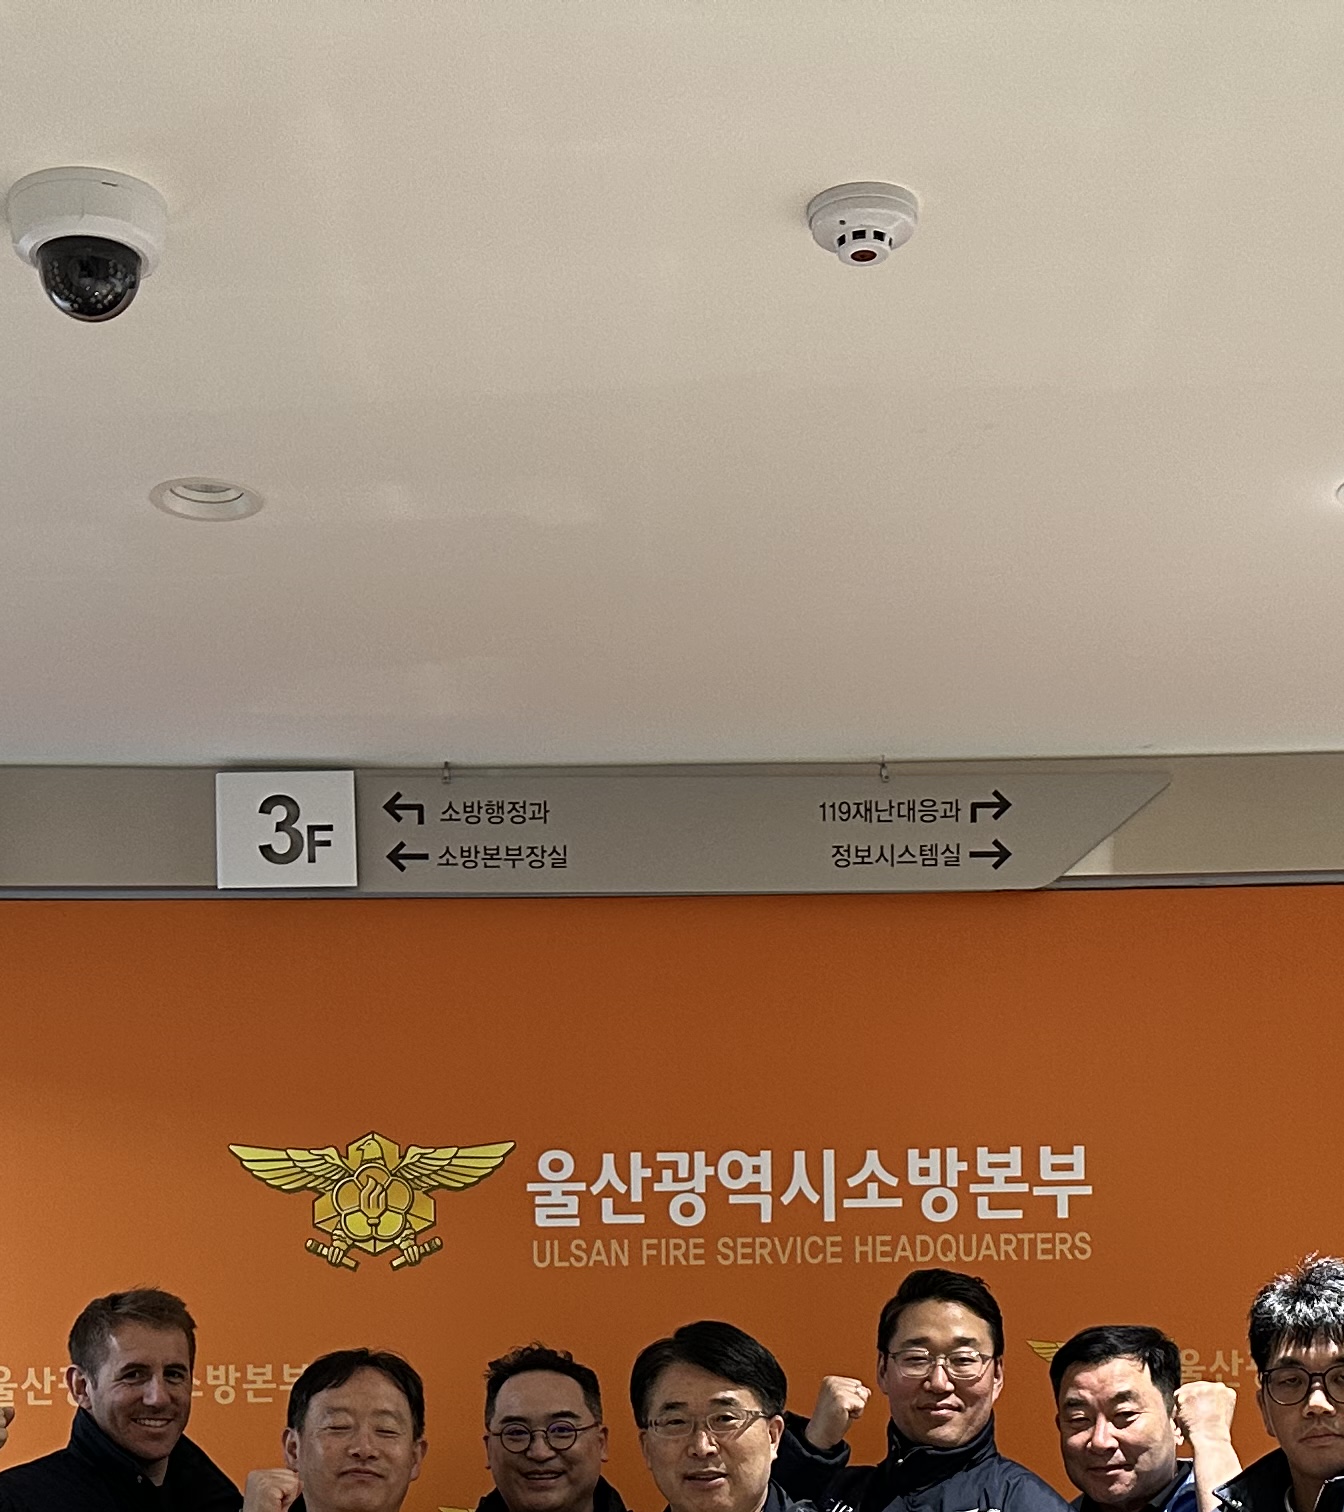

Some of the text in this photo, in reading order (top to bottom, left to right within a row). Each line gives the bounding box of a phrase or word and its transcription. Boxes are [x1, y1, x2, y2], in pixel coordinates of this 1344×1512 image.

[439, 797, 551, 827] 소방행정과
[817, 796, 963, 826] 119재난대응과
[257, 795, 335, 867] 3F
[437, 841, 570, 871] 소방본부장실
[829, 841, 963, 869] 정보시스템실
[524, 1144, 1094, 1229] 울산광역시소방본부
[532, 1231, 1093, 1268] ULSAN FIRE SERVICE HEADQUARTERS
